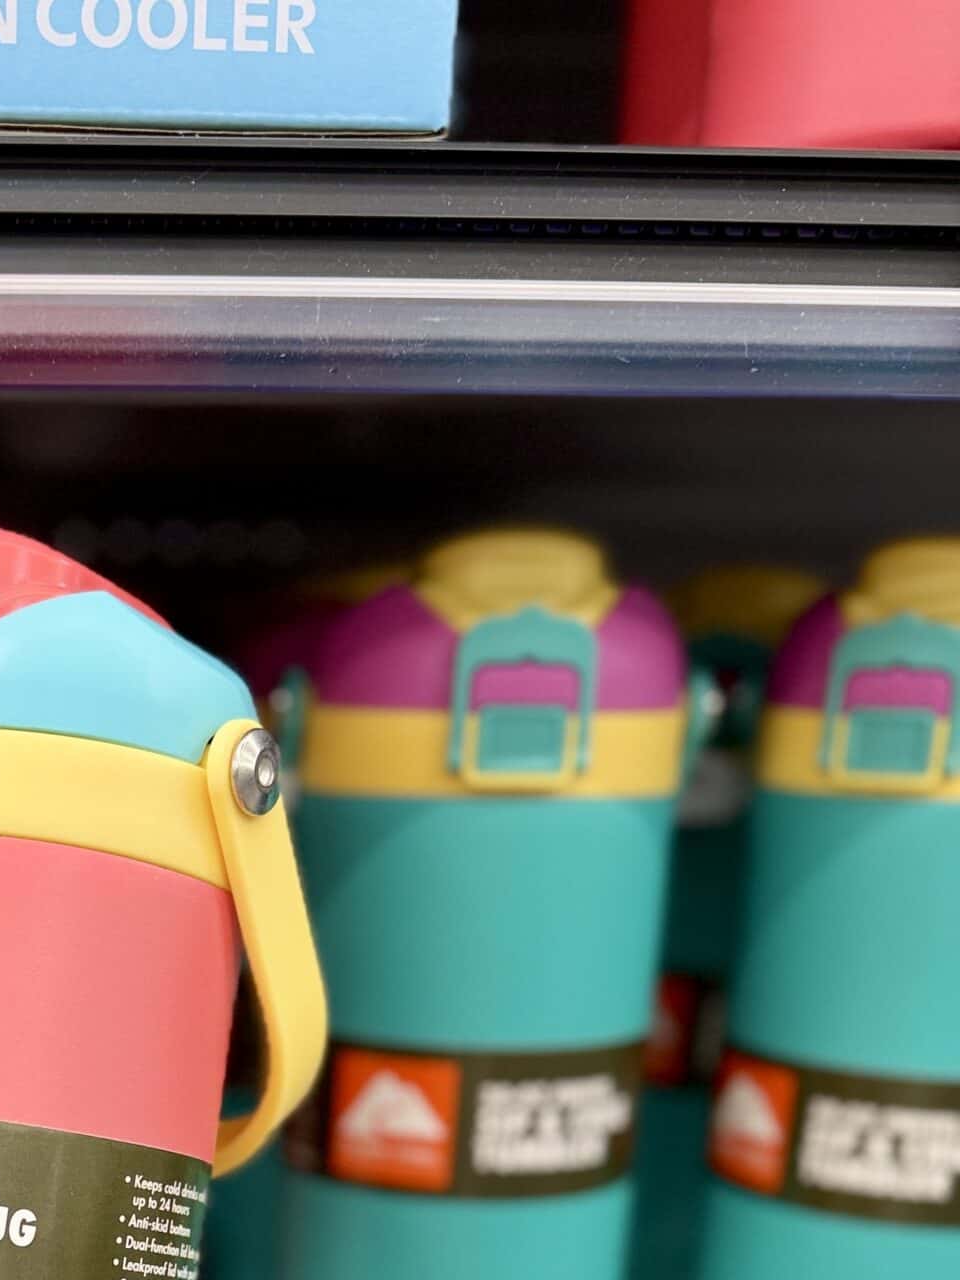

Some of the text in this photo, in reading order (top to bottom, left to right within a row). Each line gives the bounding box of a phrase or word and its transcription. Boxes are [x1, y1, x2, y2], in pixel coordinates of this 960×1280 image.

[36, 0, 316, 55] COOLER
[134, 1174, 163, 1195] Keeps
[164, 1181, 181, 1196] cold
[132, 1196, 145, 1211] up
[148, 1196, 157, 1209] to
[159, 1197, 171, 1211] 24
[128, 1213, 169, 1233] Anti-skid
[125, 1235, 179, 1256] Dual-function
[122, 1257, 167, 1277] Leakproof
